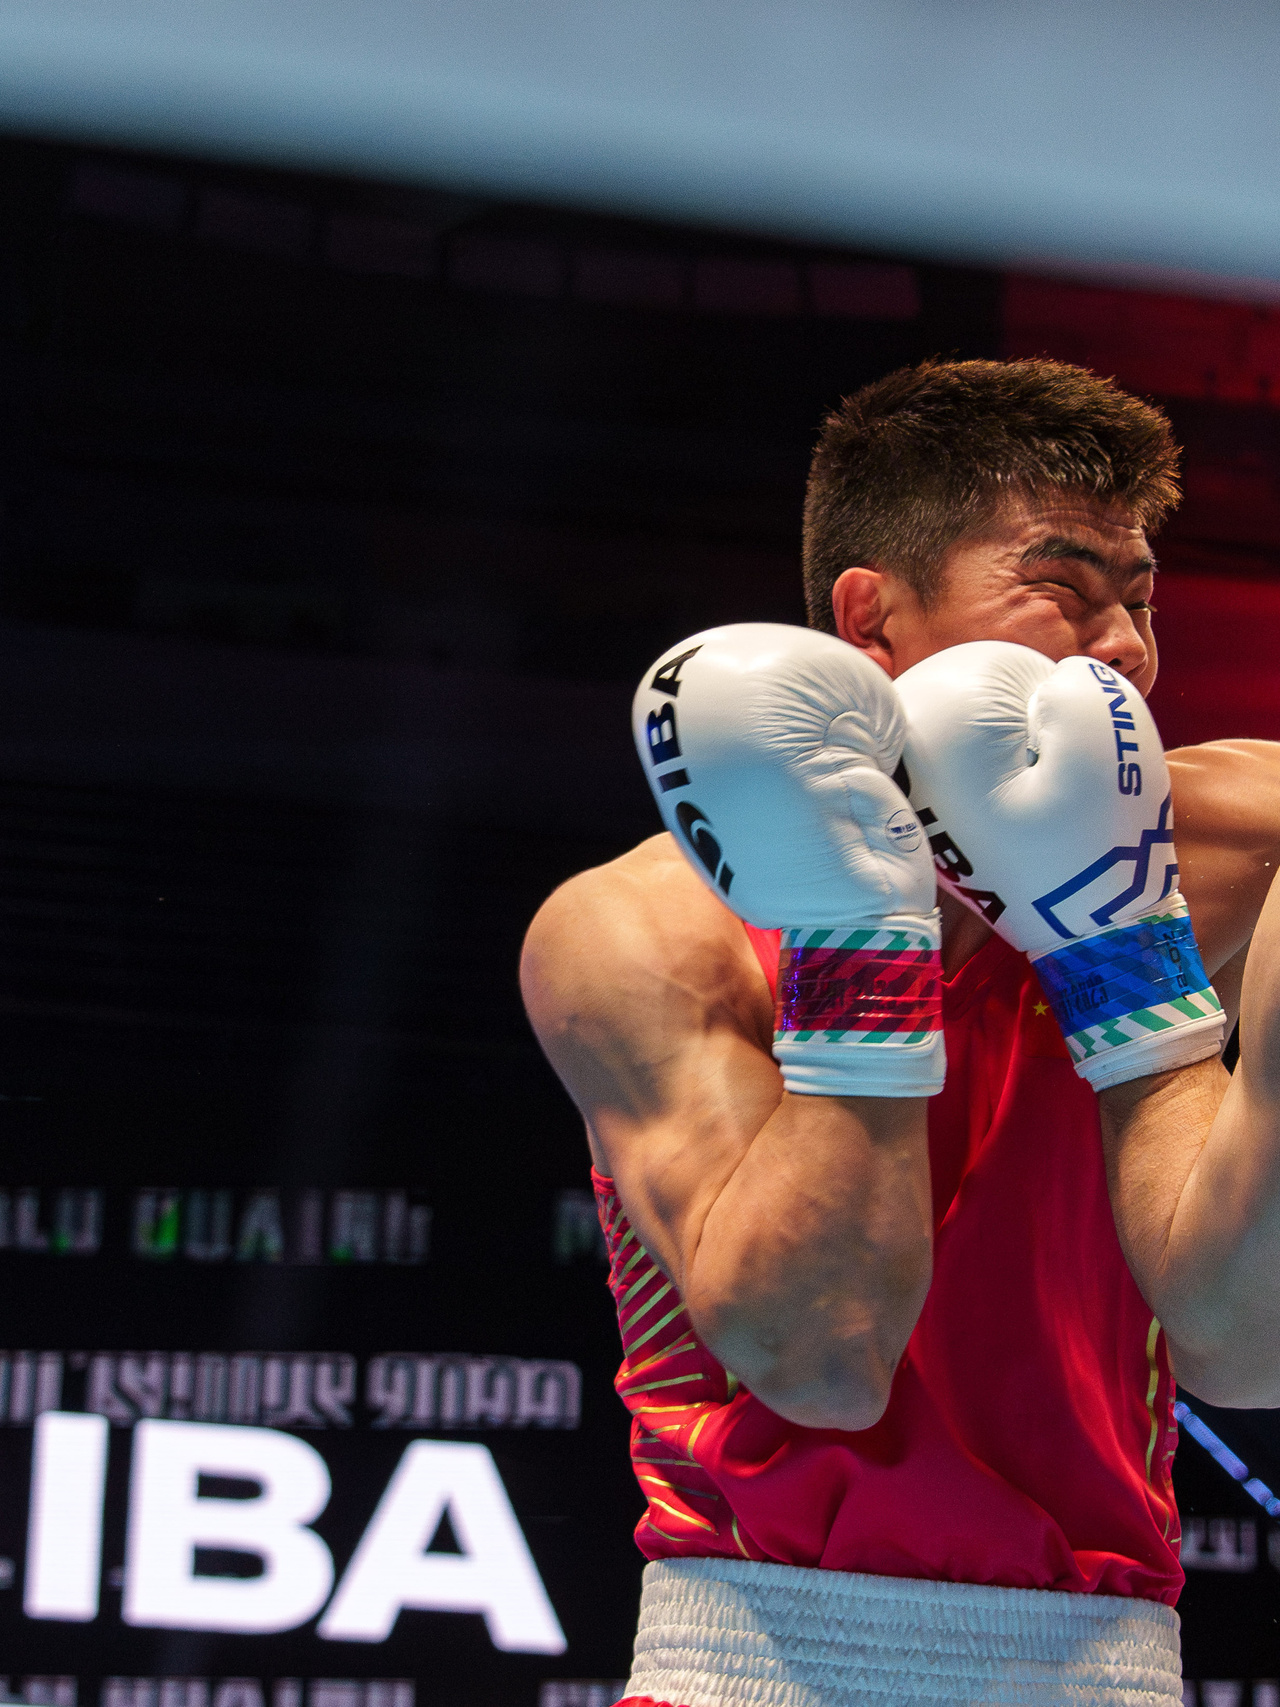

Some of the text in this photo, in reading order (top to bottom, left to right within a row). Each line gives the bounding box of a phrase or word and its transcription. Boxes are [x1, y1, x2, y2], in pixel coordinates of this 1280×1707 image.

[648, 644, 705, 795] IBA
[1088, 663, 1143, 797] STING
[23, 1410, 569, 1656] IBA
